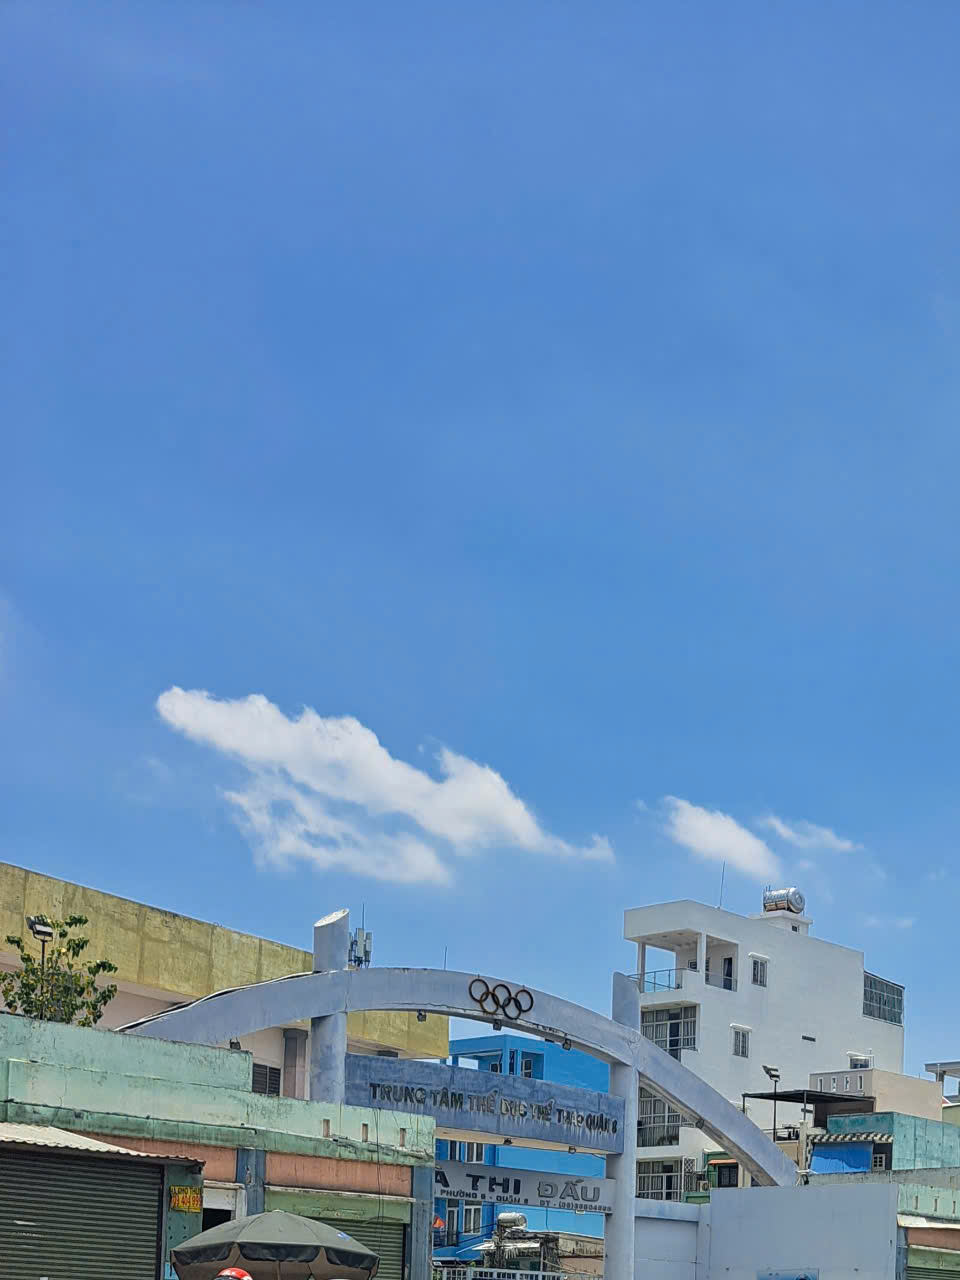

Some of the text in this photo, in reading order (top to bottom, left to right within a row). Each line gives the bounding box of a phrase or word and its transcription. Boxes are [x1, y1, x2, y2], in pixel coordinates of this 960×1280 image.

[369, 1083, 426, 1104] TRUNG
[430, 1087, 464, 1110] TÂM
[466, 1173, 521, 1195] THI
[537, 1179, 600, 1202] ĐẤU
